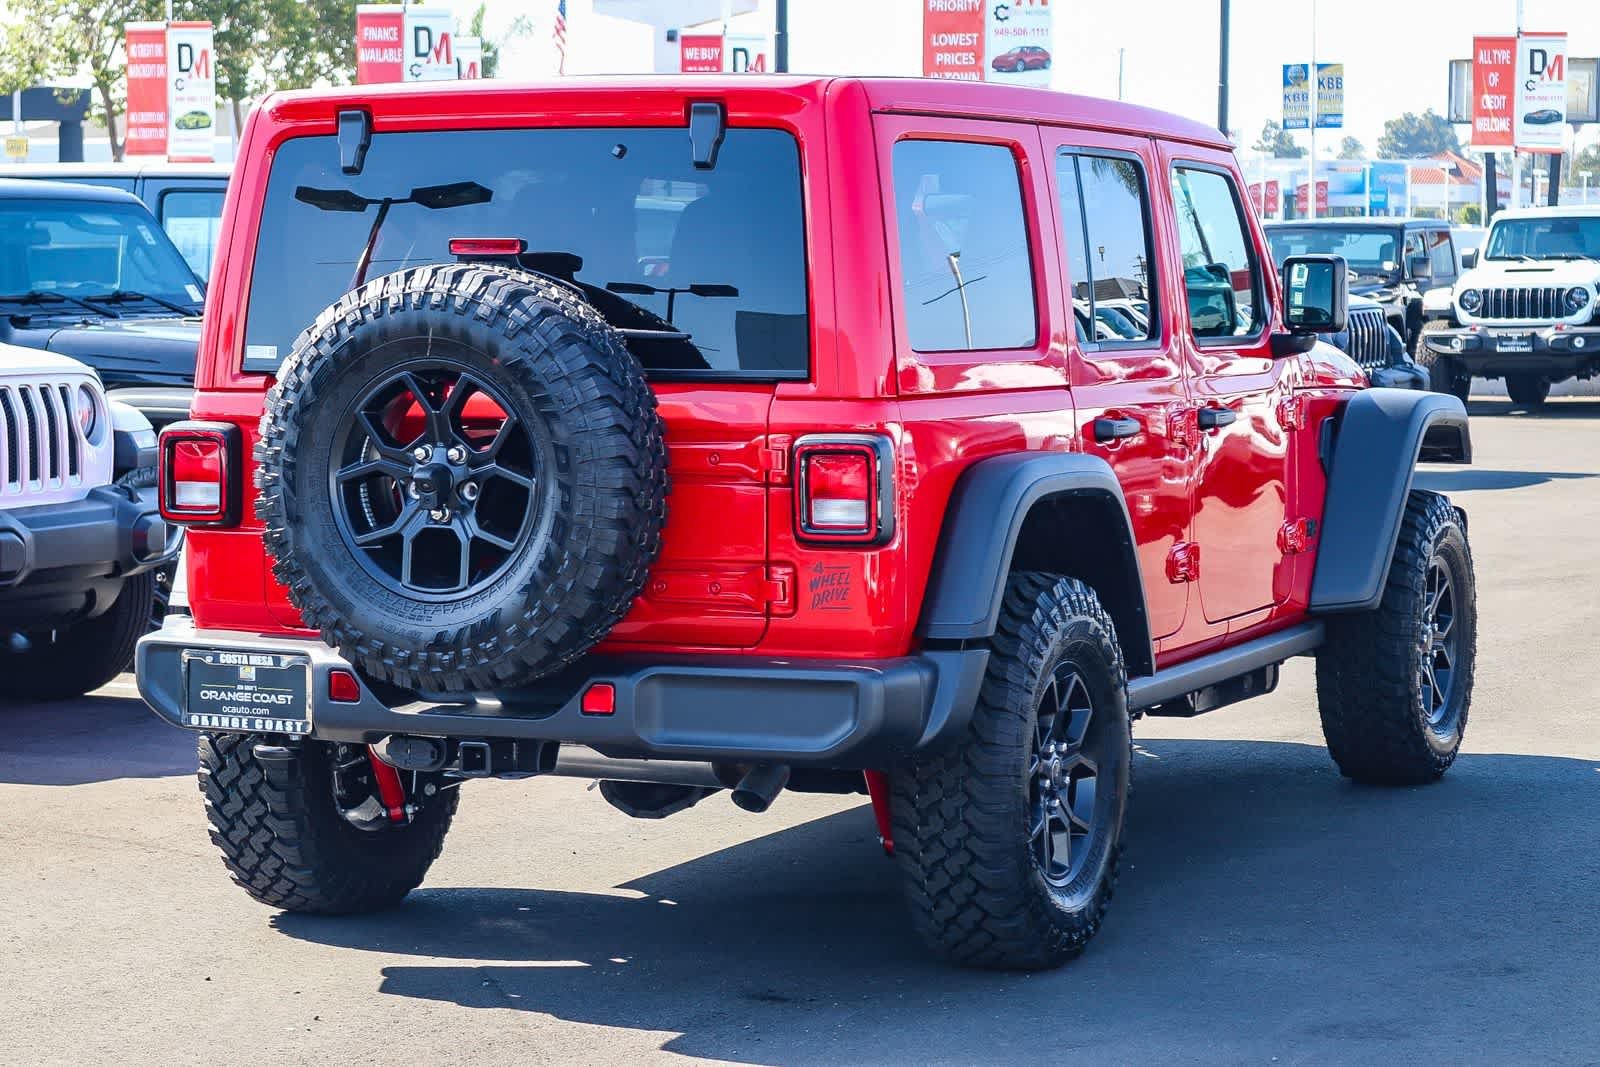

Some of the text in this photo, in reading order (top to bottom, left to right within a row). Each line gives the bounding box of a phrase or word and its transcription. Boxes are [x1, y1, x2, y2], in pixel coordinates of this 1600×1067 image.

[928, 0, 981, 12] PRIORITY
[363, 26, 399, 41] FINANCE
[932, 33, 979, 46] LOWEST
[360, 47, 404, 63] AVAILABLE
[685, 47, 720, 60] WE BUY
[935, 52, 976, 65] PRICES
[1479, 49, 1511, 65] ALL TYPE
[1318, 77, 1343, 89] KBB
[1488, 72, 1500, 87] OF
[1475, 117, 1511, 132] WELCOME
[809, 572, 850, 592] WHEEL
[811, 587, 850, 609] DRIVE
[220, 653, 274, 666] COSTA MESA
[200, 690, 293, 705] ORANGE COAST
[222, 705, 270, 715] ocauto.com
[190, 714, 304, 732] ORANGE COAST
